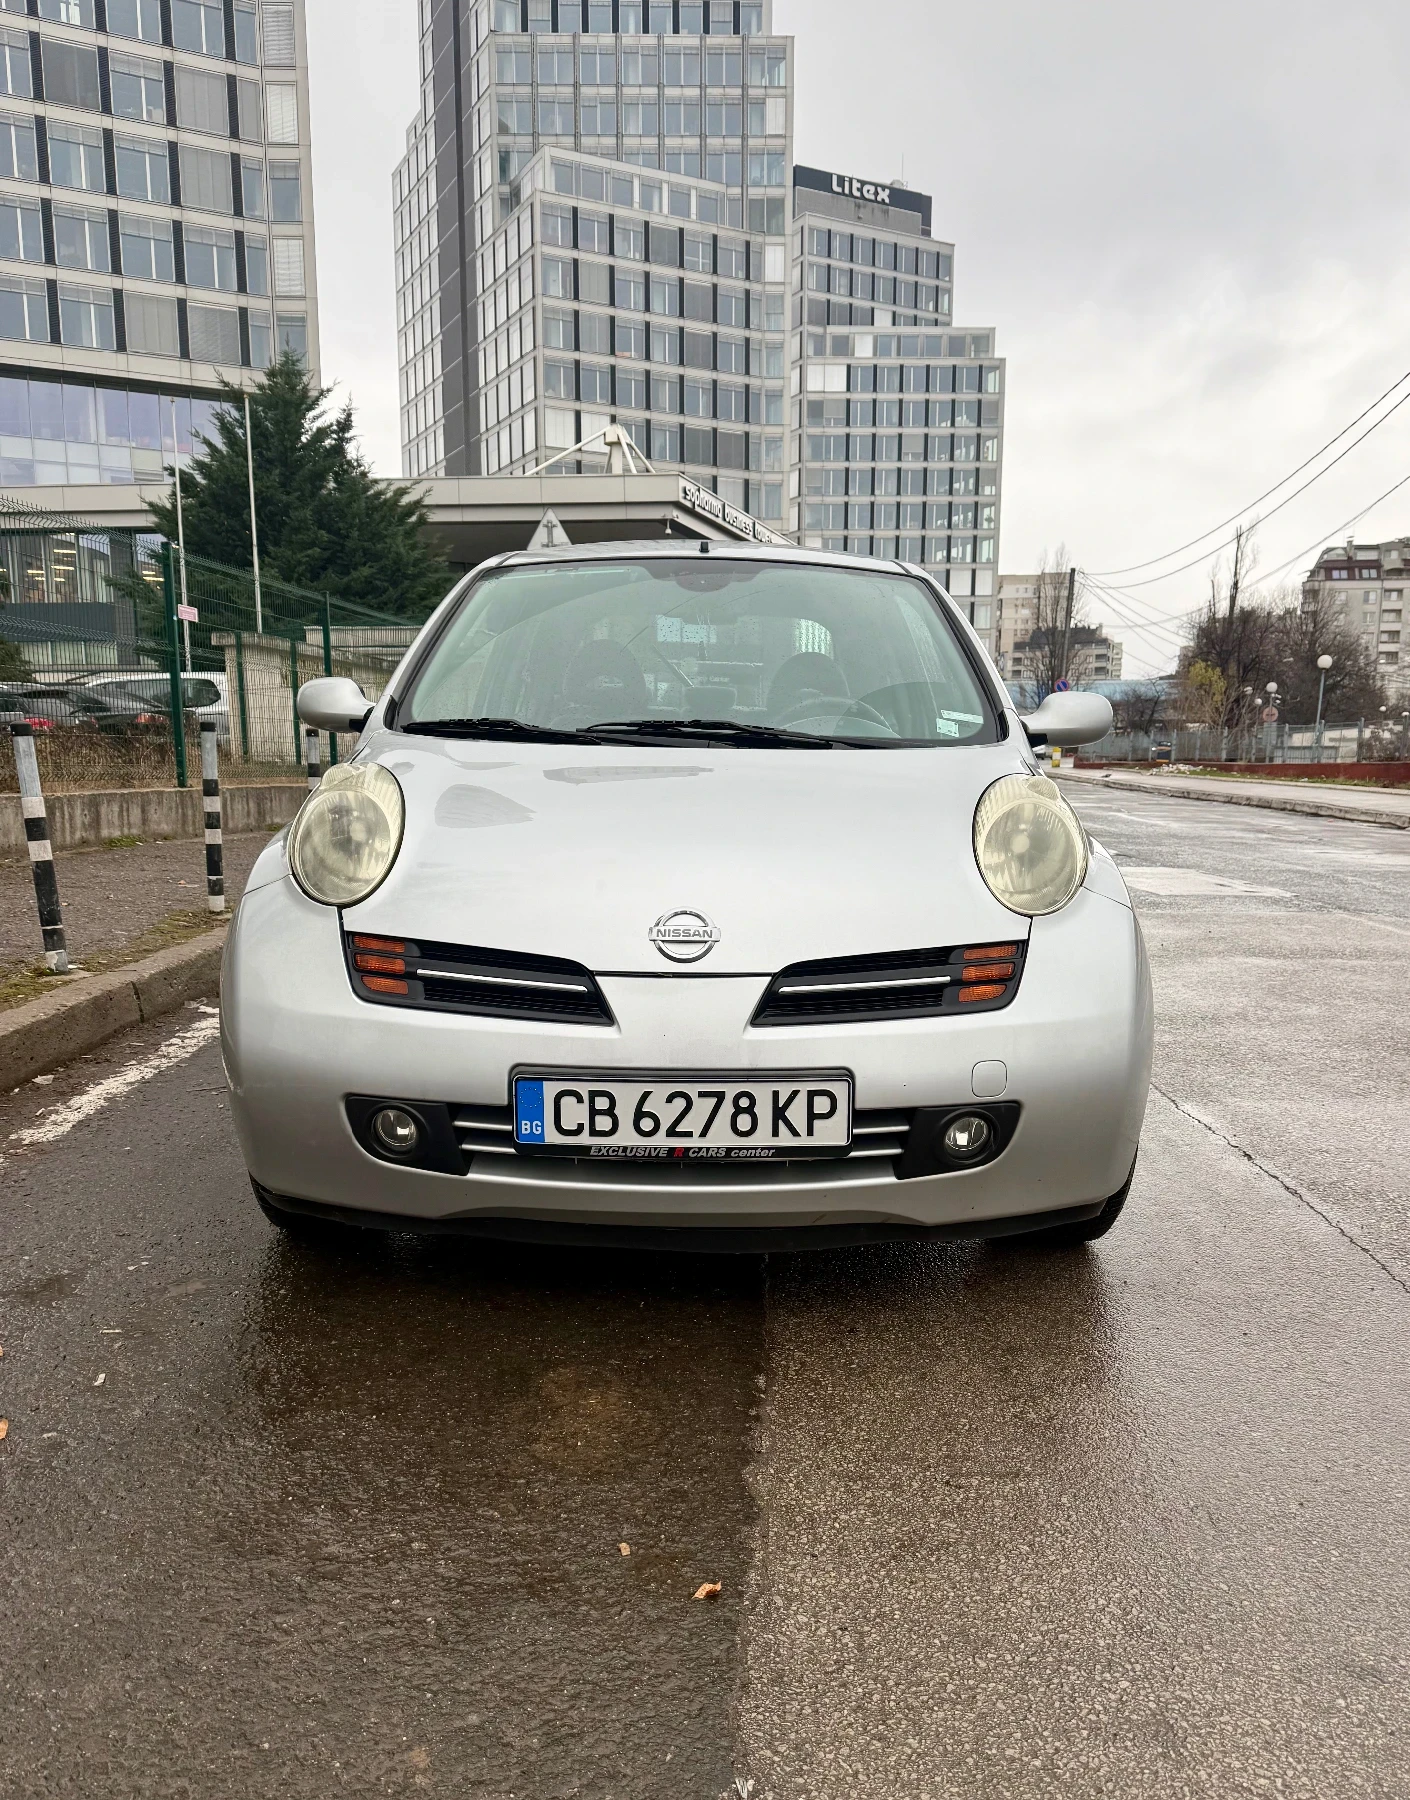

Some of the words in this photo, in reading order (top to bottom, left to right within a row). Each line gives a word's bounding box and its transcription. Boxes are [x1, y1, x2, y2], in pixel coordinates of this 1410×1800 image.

[831, 173, 890, 204] Litex
[684, 485, 723, 518] sopharma
[656, 928, 713, 939] NISSAN
[553, 1089, 620, 1137] CB
[632, 1089, 759, 1138] 6278
[771, 1088, 838, 1137] KP
[521, 1120, 542, 1135] BG
[589, 1146, 669, 1158] EXCLUSIVE
[688, 1147, 727, 1158] CARS
[730, 1147, 776, 1158] center
